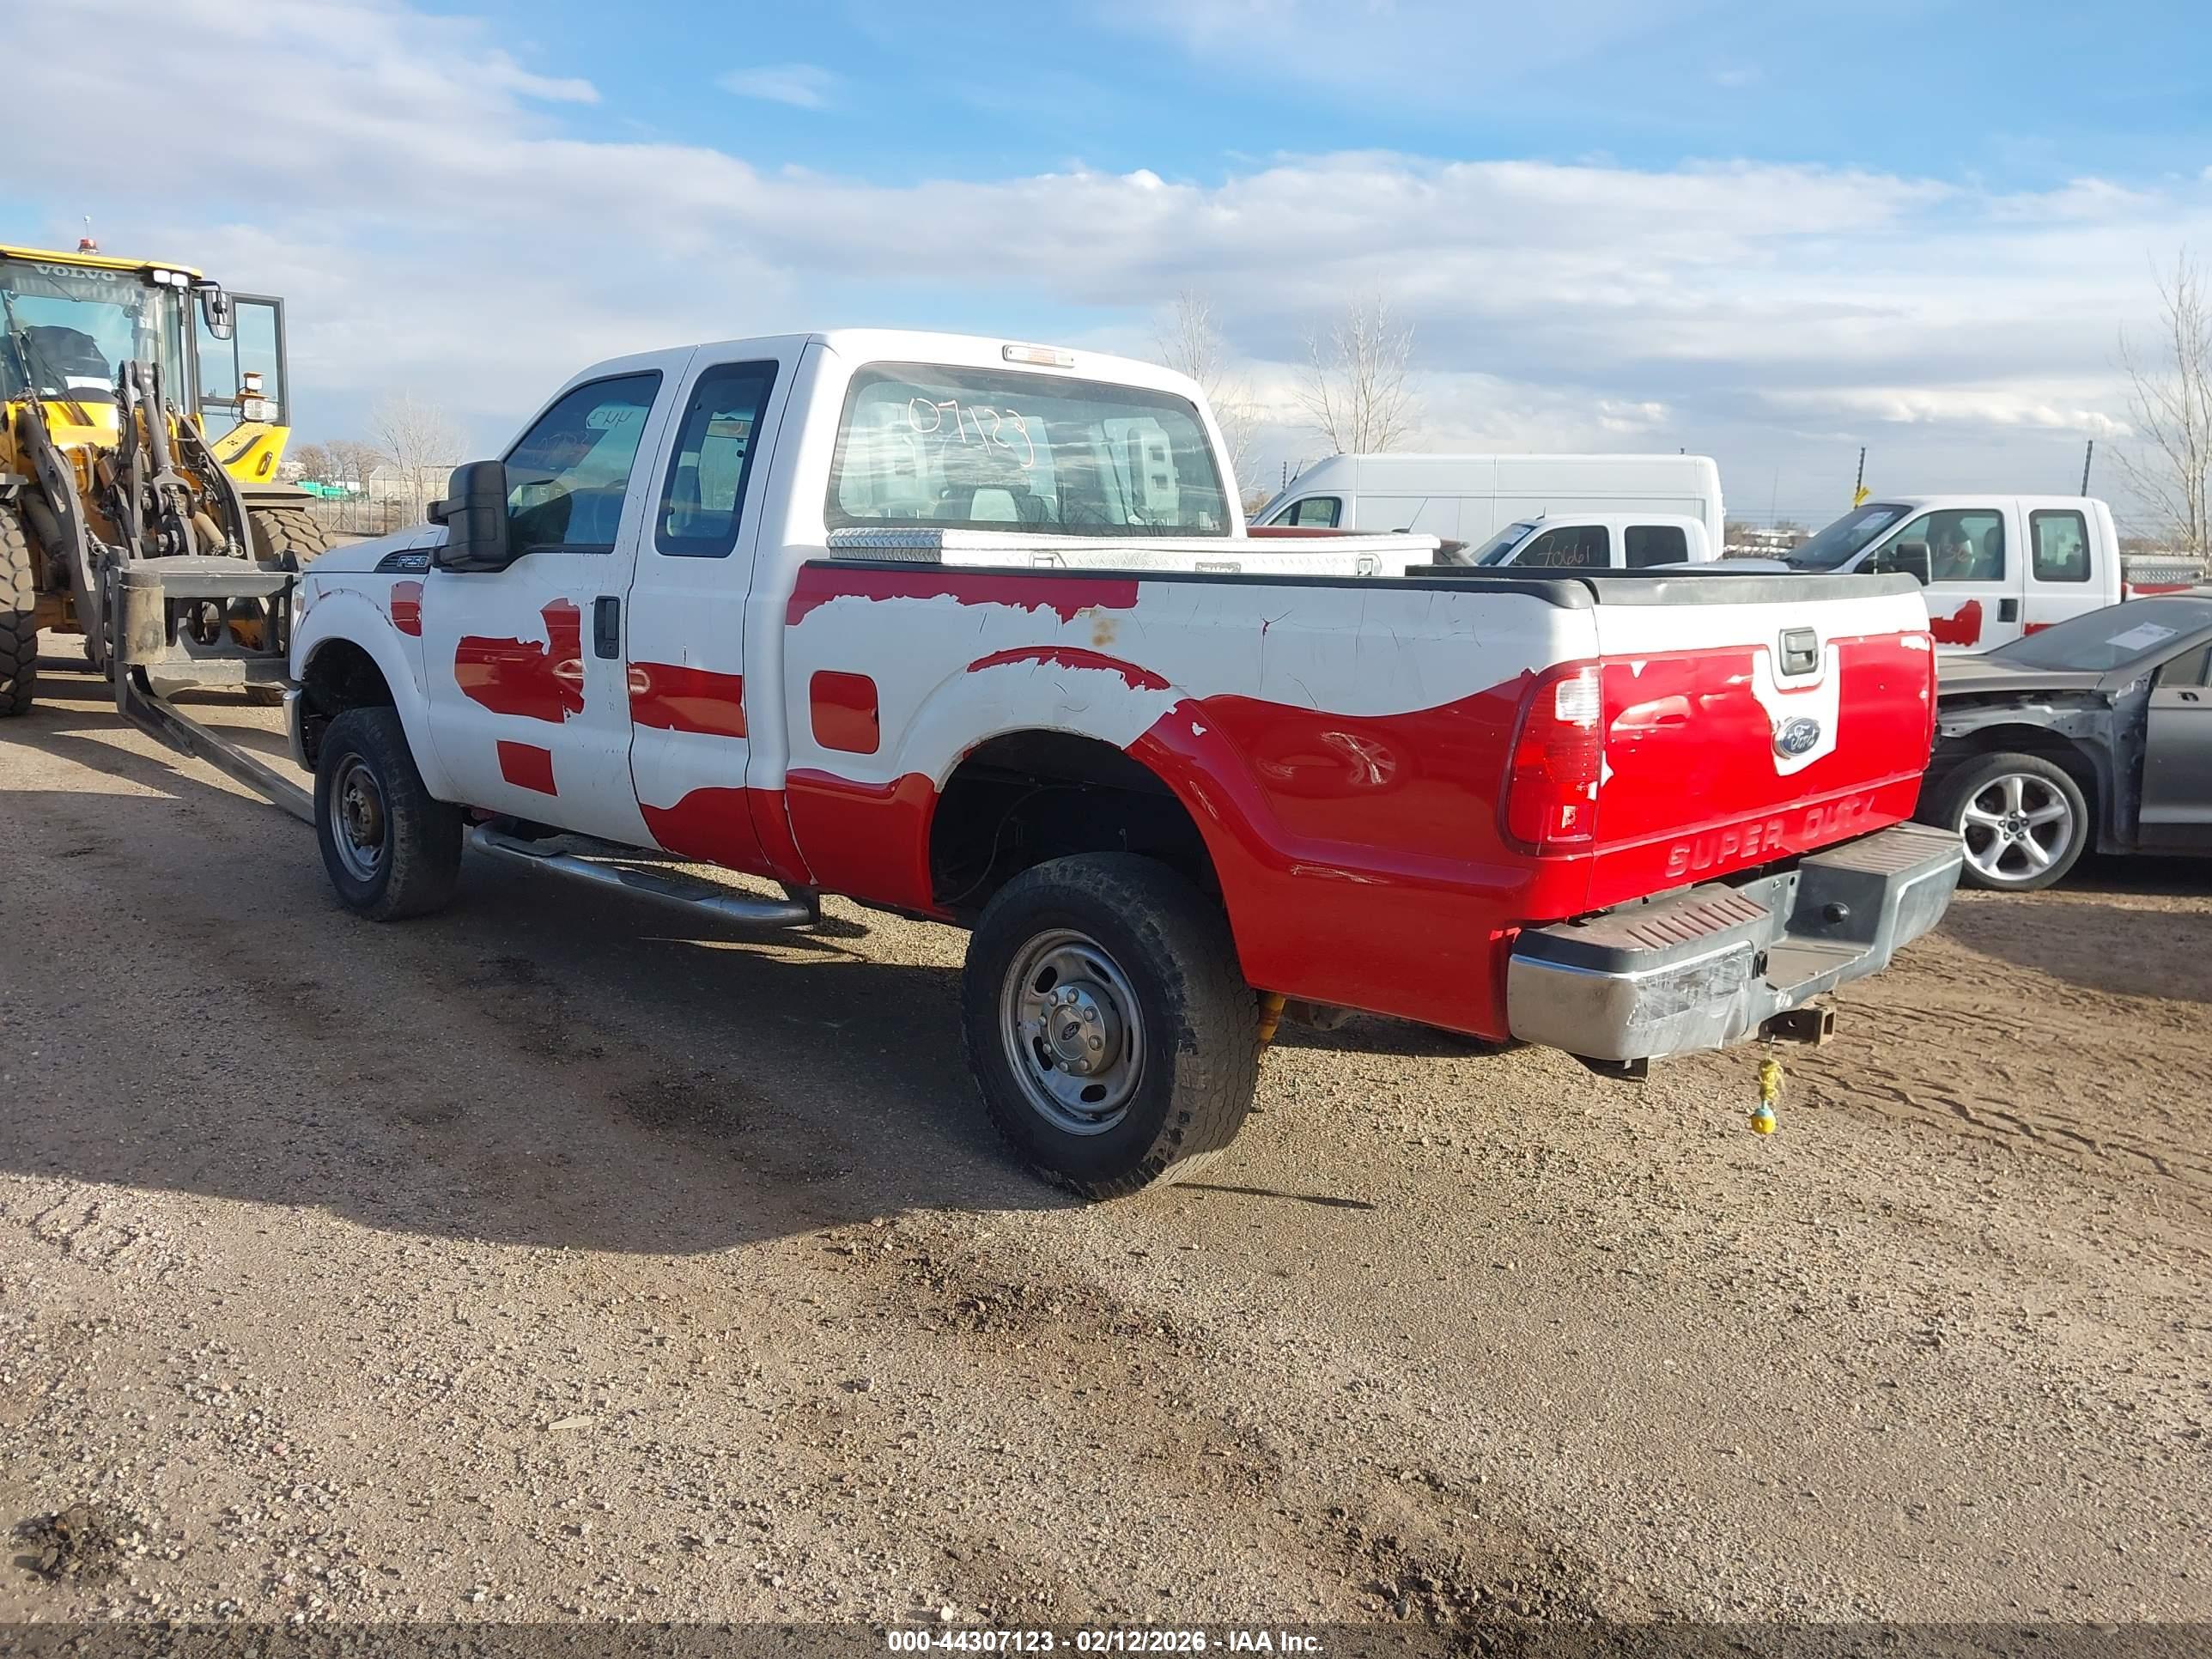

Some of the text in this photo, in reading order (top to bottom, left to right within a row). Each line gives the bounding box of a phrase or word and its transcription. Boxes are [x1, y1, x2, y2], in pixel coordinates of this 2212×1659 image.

[32, 263, 118, 282] VOLVO
[908, 398, 1035, 468] 07123
[1787, 724, 1816, 750] Ford
[1664, 795, 1875, 878] SUPER DUTY
